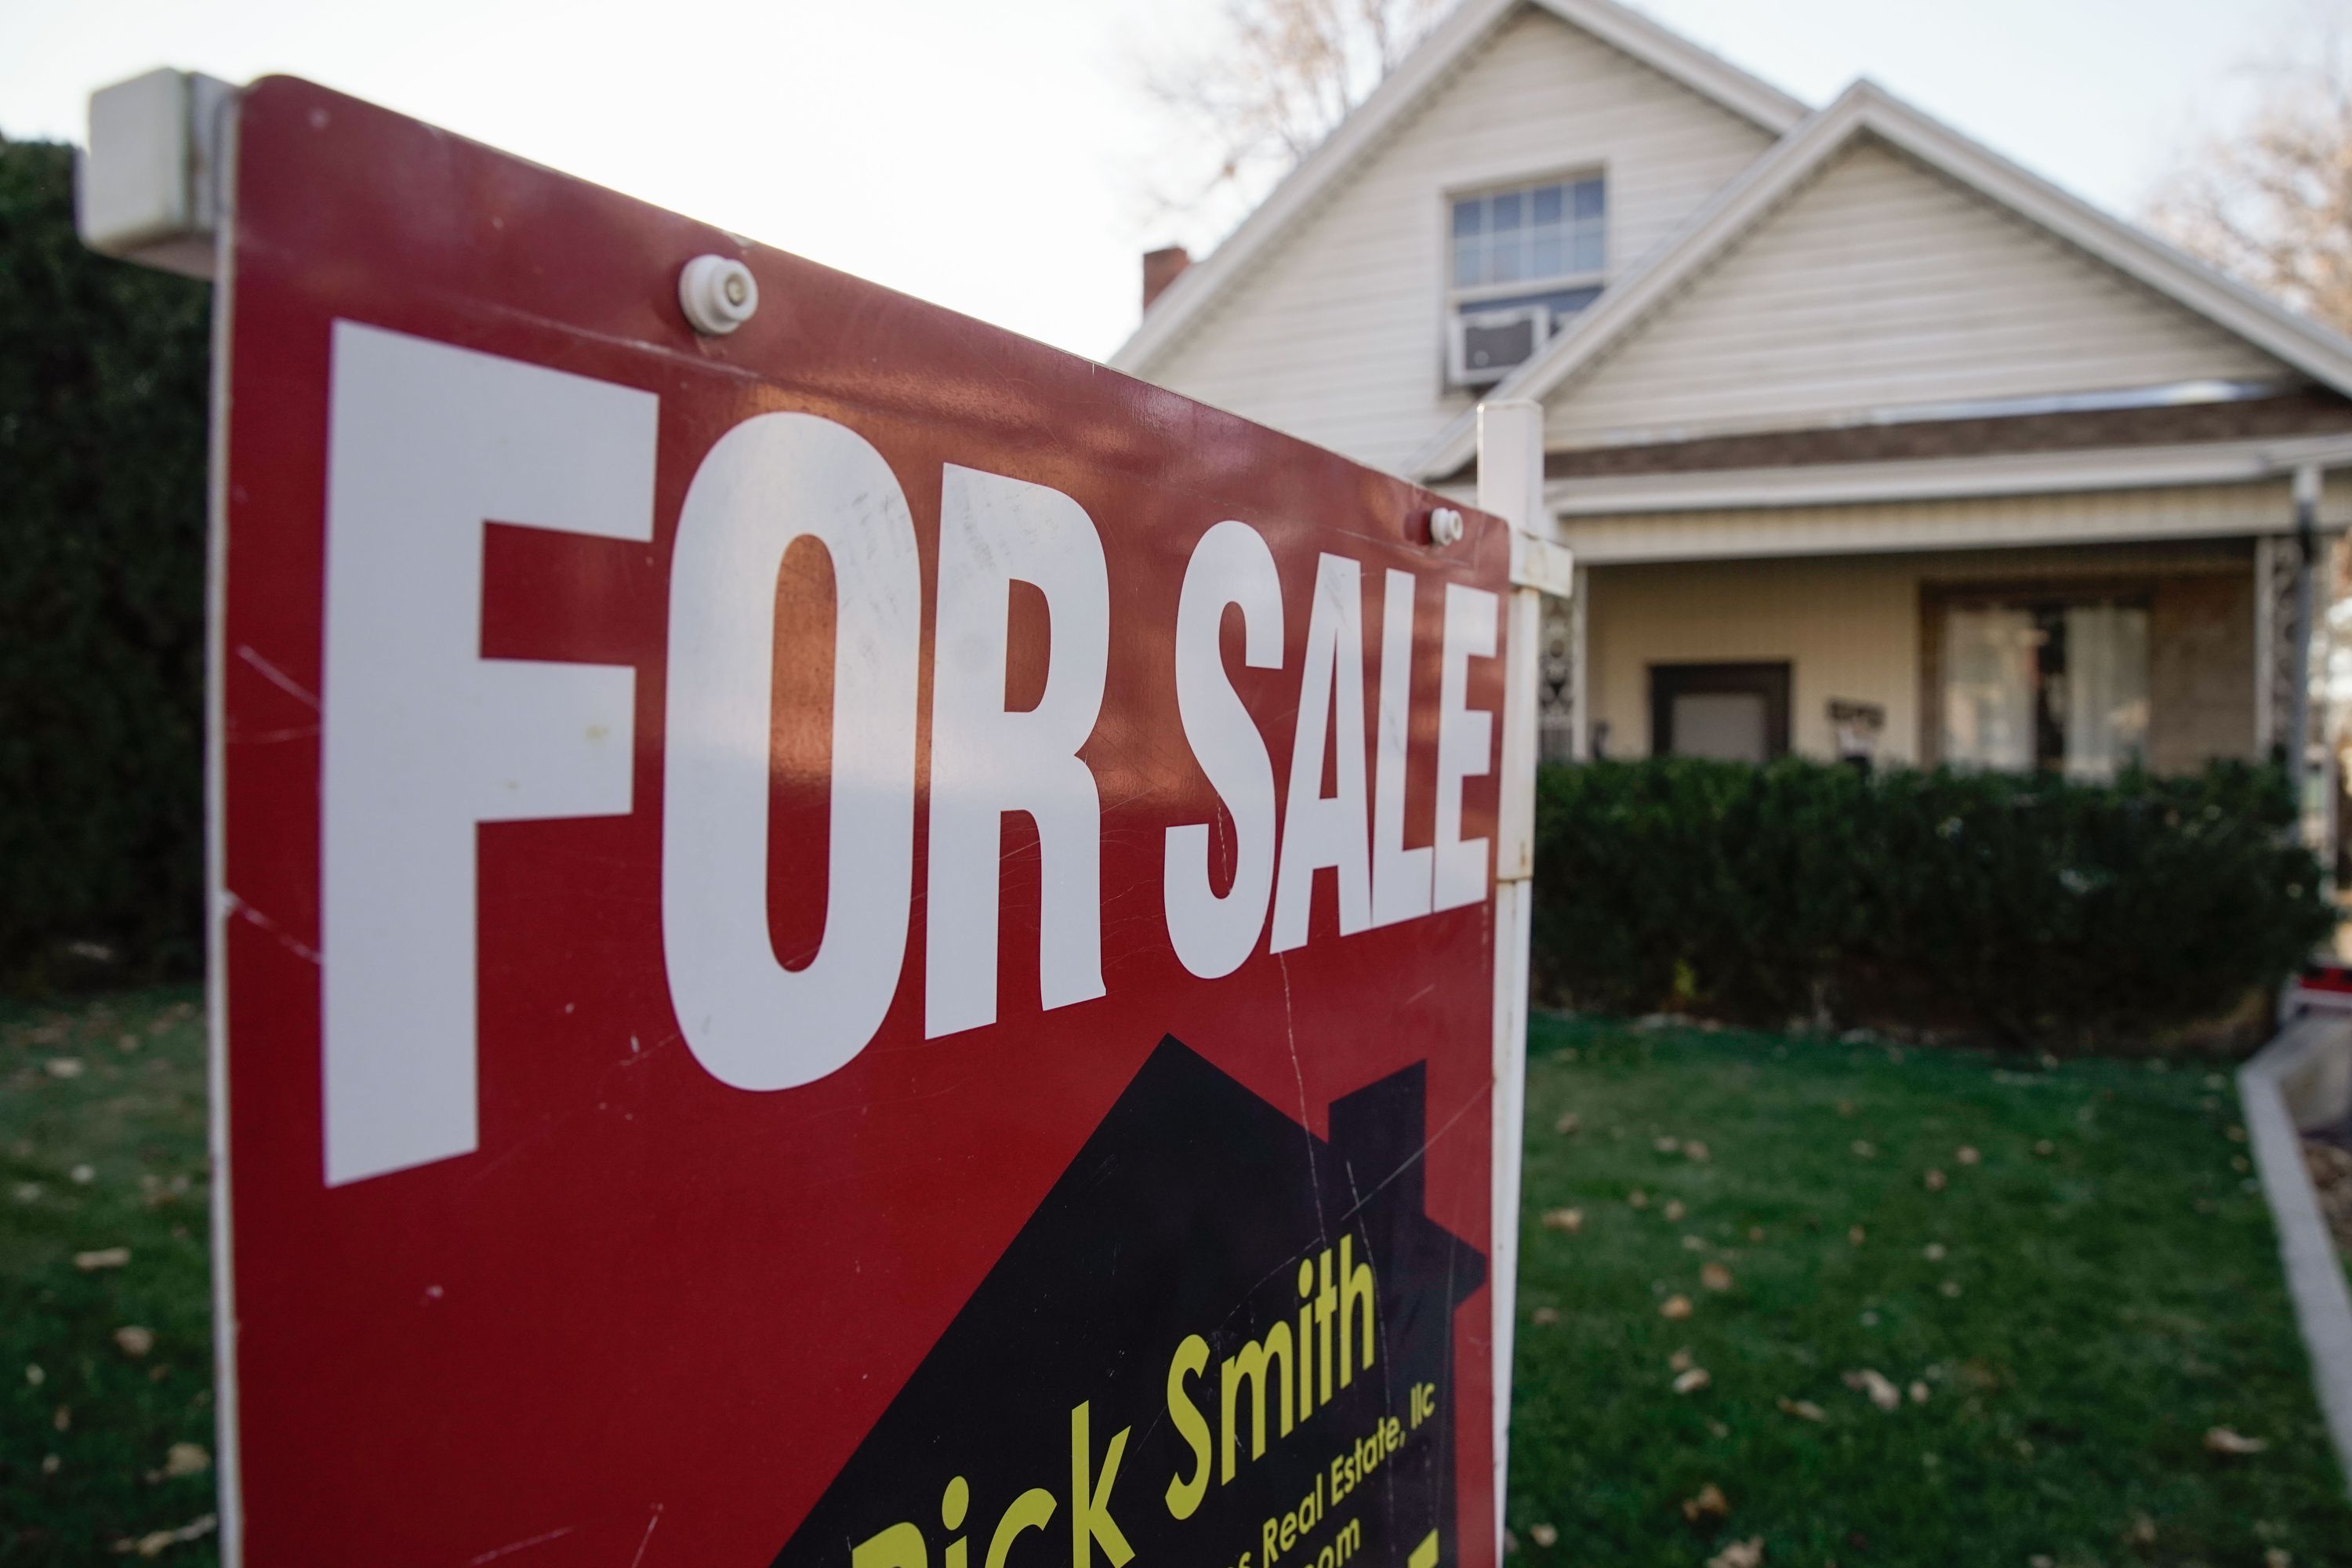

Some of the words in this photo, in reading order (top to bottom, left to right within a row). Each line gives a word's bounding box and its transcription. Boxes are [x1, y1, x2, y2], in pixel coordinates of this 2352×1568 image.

[323, 320, 1109, 1185] FOR
[1164, 521, 1499, 979] SALE
[1165, 1233, 1374, 1520] Smith
[1263, 1472, 1323, 1568] Real
[1330, 1416, 1406, 1507] Estate,
[1410, 1382, 1436, 1431] llc
